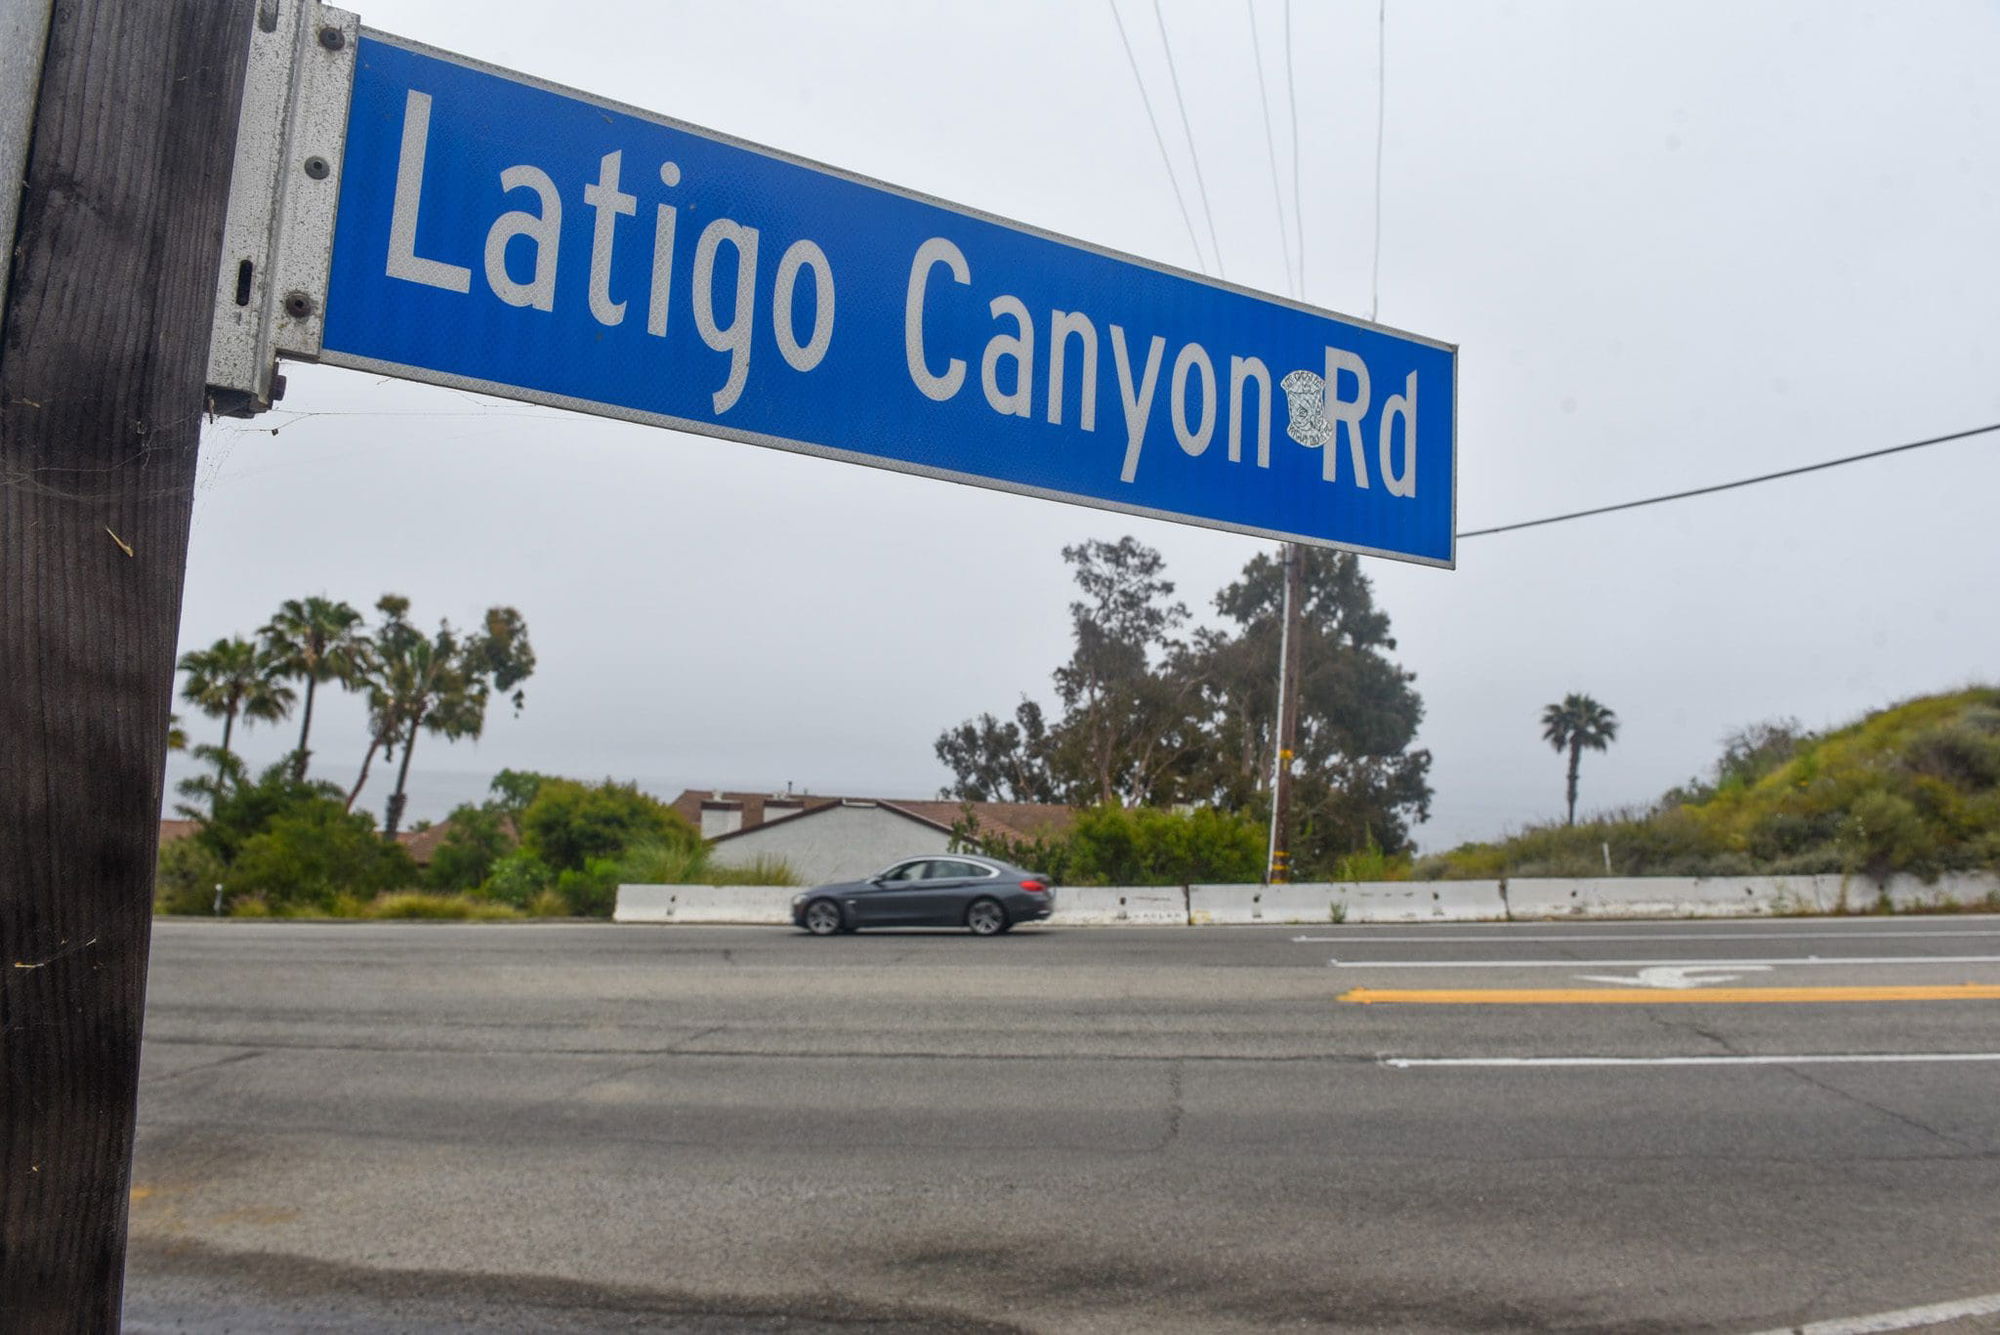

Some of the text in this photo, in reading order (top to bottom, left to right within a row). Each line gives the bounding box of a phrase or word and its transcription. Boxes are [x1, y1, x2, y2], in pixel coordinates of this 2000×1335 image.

[386, 90, 1417, 498] Latigo Canyon Rd
